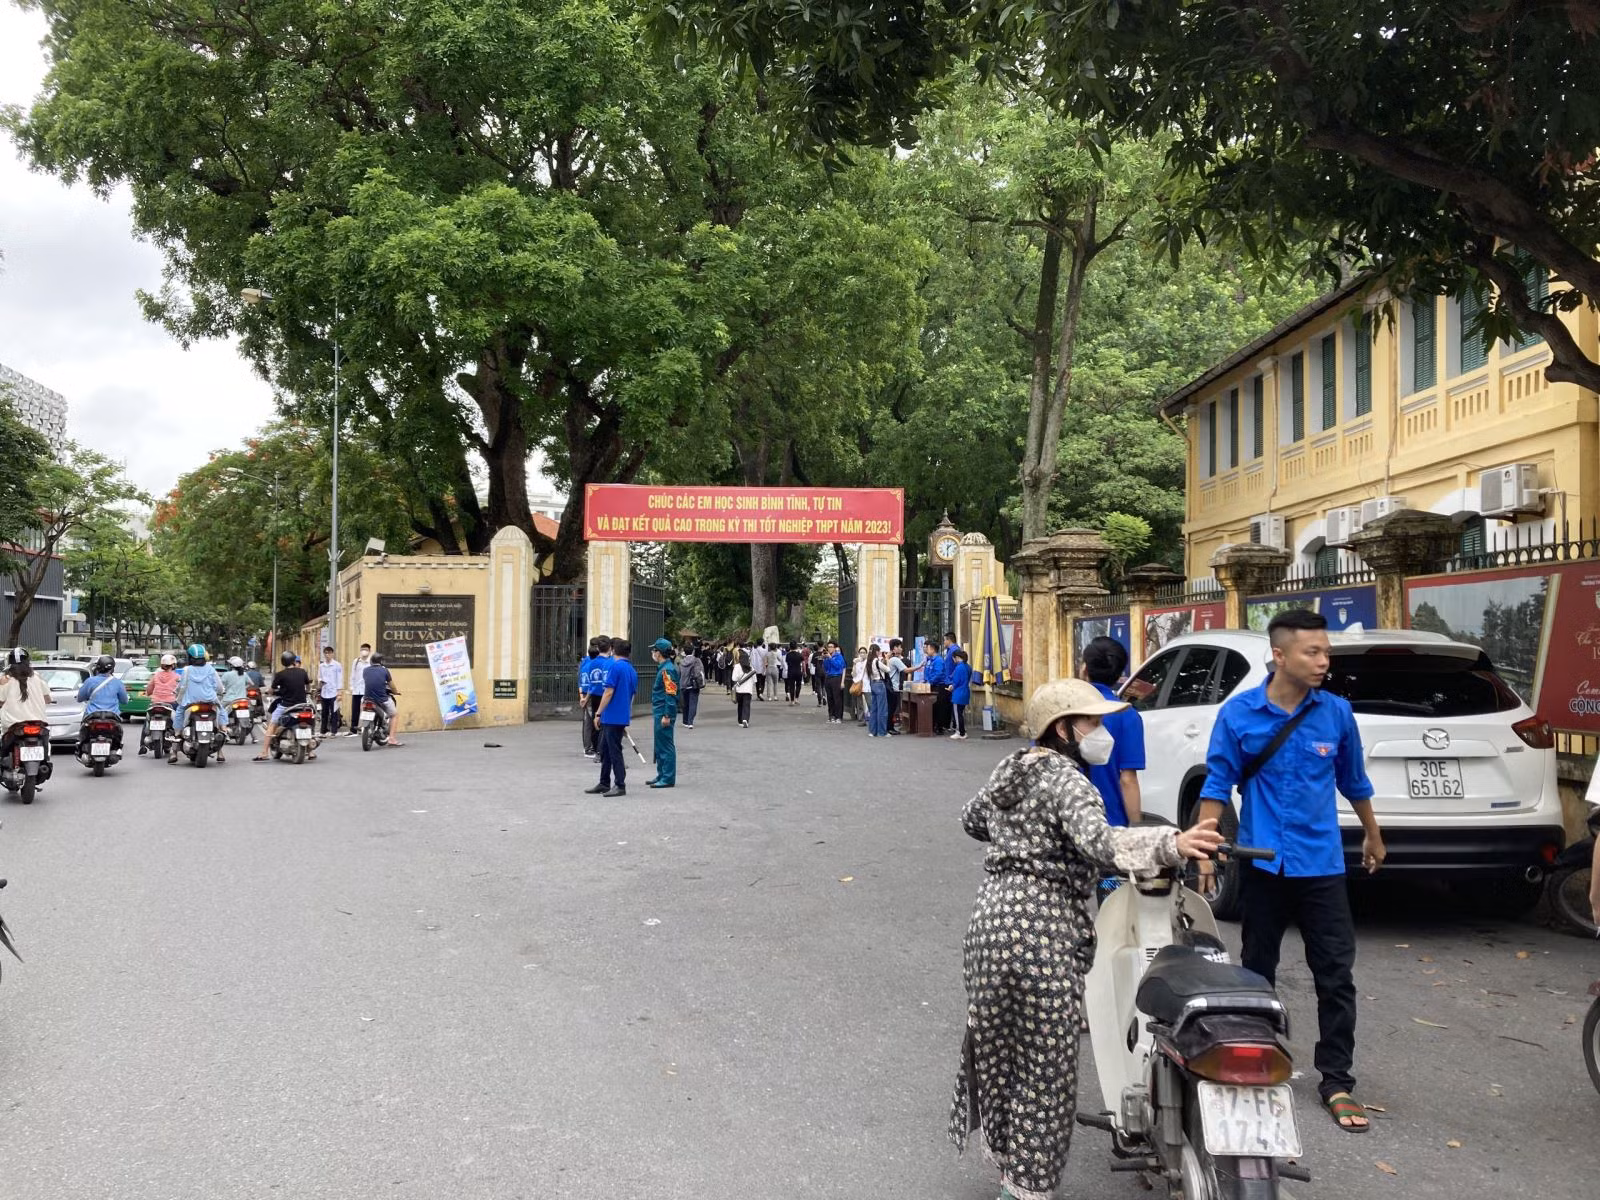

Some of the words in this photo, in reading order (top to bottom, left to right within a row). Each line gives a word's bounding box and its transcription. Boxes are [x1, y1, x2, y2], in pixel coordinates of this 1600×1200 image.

[648, 492, 674, 509] CHÚC
[676, 492, 695, 509] CÁC
[697, 496, 712, 509] EM
[715, 496, 734, 512] HỌC
[736, 496, 759, 510] SINH
[761, 494, 784, 510] BÌNH
[813, 496, 826, 513] TỰ
[827, 497, 842, 511] TIN
[597, 514, 610, 531] VÀ
[612, 516, 630, 534] ĐẠT
[632, 513, 650, 532] KẾT
[652, 513, 671, 533] QUẢ
[674, 518, 692, 532] CAO
[695, 518, 726, 532] TRONG
[728, 515, 740, 532] KỲ
[743, 519, 757, 533] THI
[760, 515, 777, 533] TỐT
[779, 517, 813, 536] NGHIỆP
[816, 519, 838, 534] THPT
[841, 517, 863, 534] NĂM
[865, 520, 892, 534] 2023!
[383, 630, 414, 640] CHU
[418, 628, 446, 641] VĂN
[1419, 761, 1449, 778] 30E
[1411, 779, 1462, 796] 651.62
